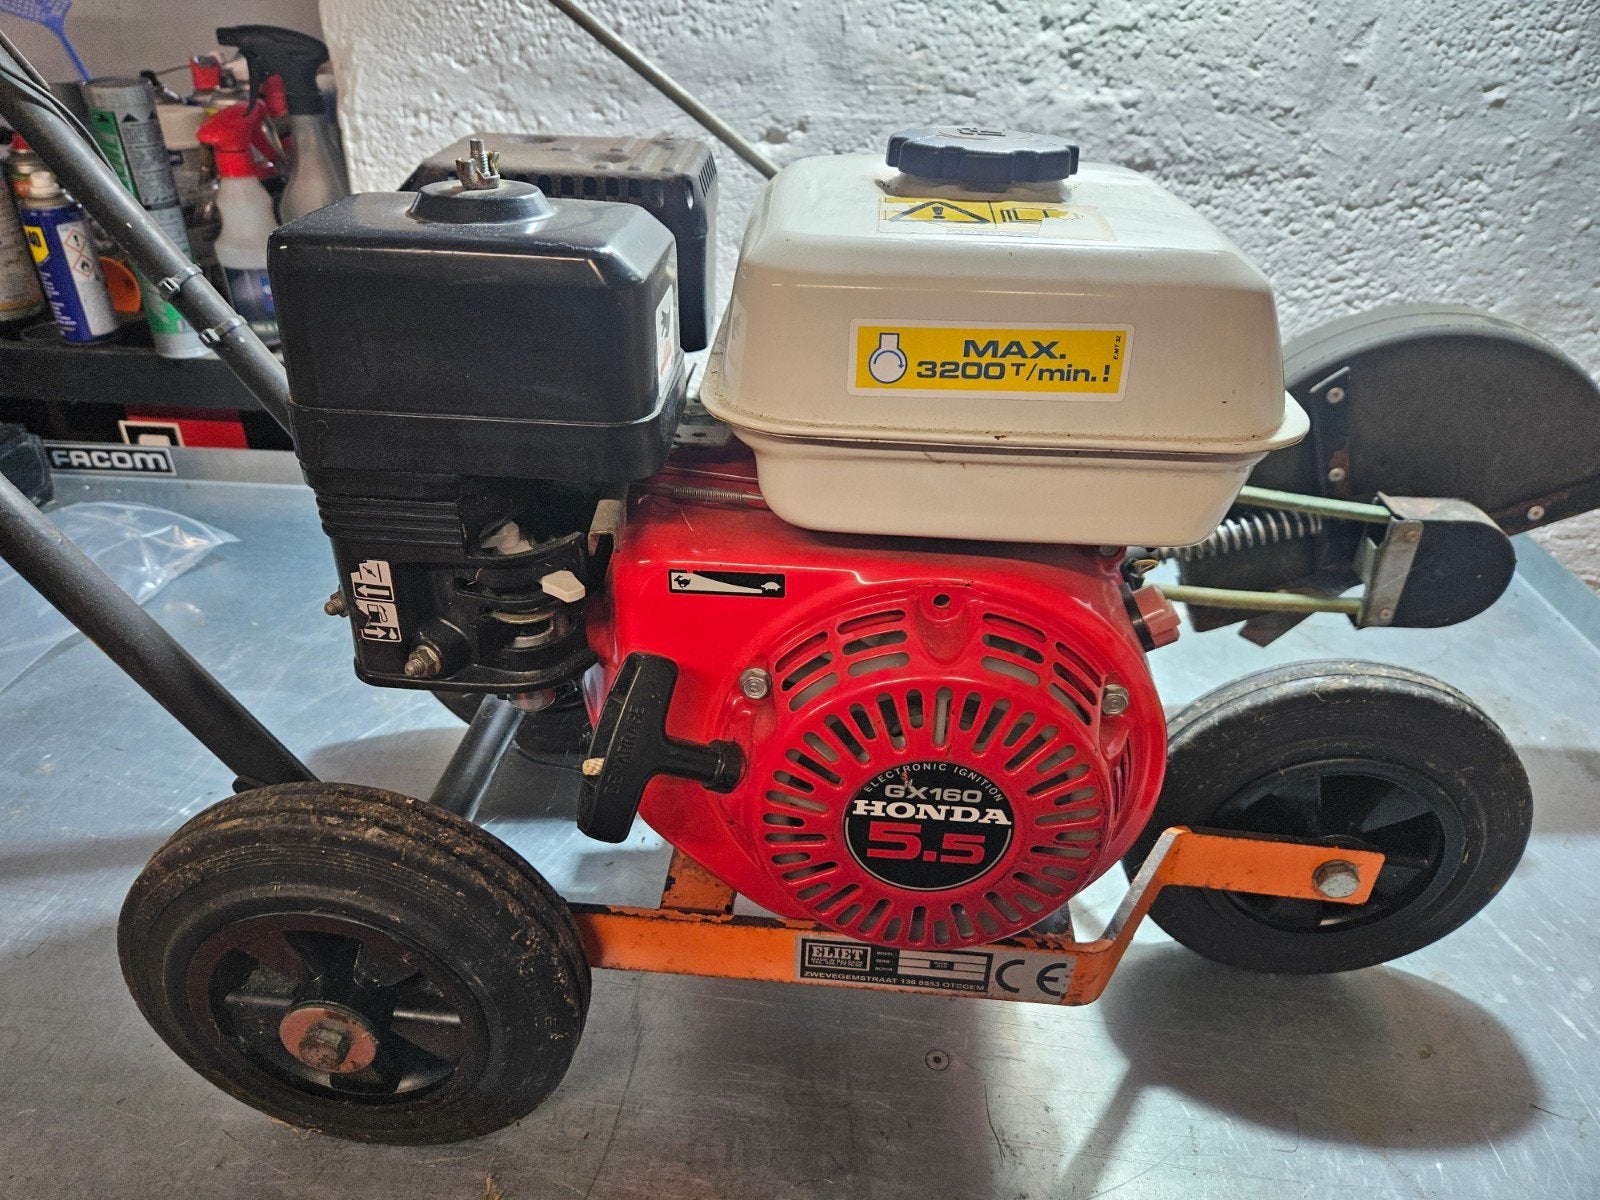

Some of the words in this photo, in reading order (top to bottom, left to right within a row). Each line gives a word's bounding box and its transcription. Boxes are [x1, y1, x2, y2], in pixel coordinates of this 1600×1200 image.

[963, 339, 1066, 360] MAX.
[52, 450, 168, 470] FACOM
[863, 762, 948, 793] ELECTRONIC
[953, 766, 1004, 802] IGNITION
[884, 784, 983, 803] GX160
[852, 799, 1012, 826] HONDA
[866, 820, 986, 865] 5.5
[811, 946, 864, 961] ELIET
